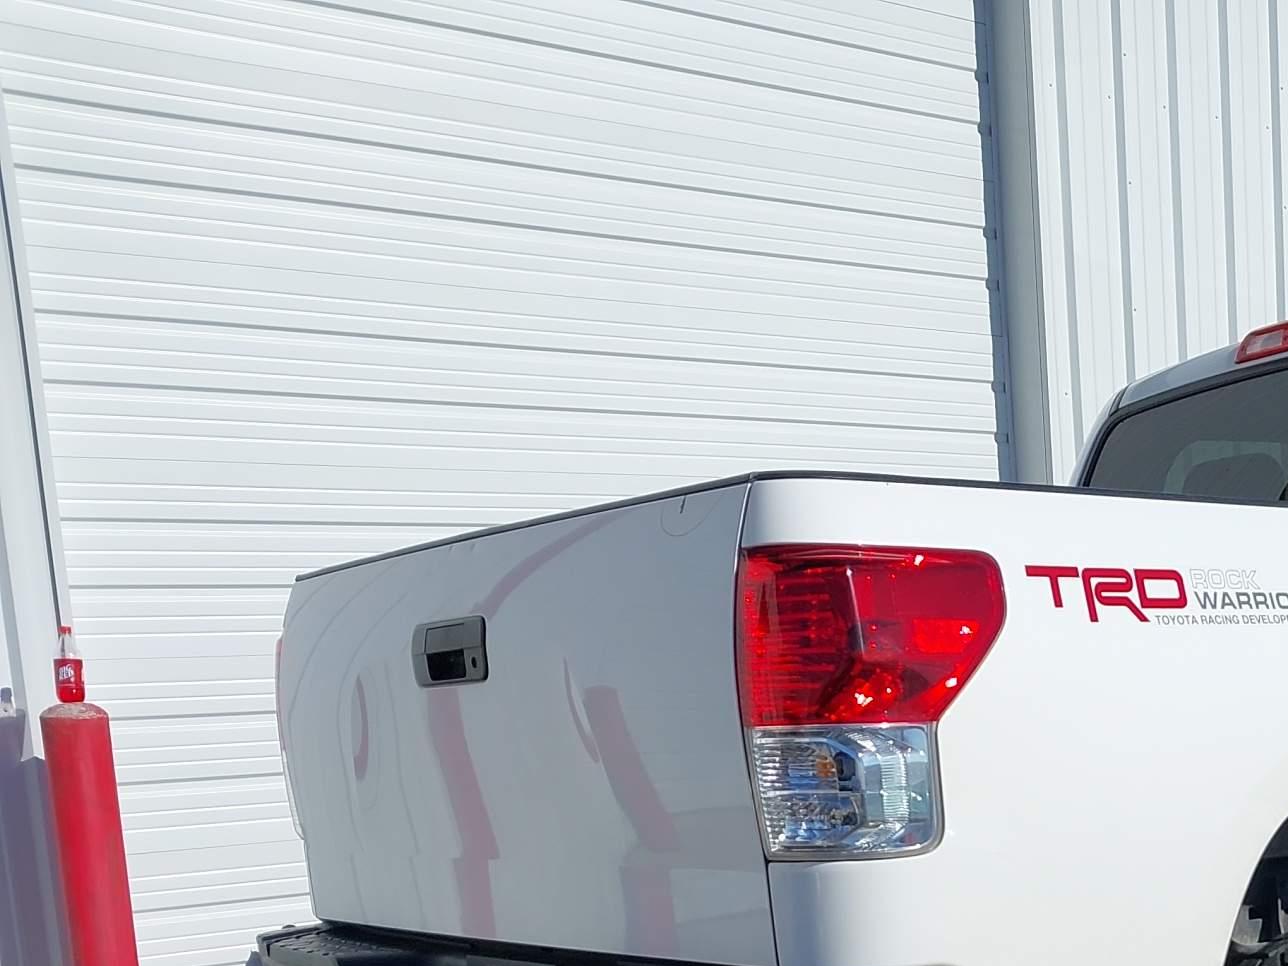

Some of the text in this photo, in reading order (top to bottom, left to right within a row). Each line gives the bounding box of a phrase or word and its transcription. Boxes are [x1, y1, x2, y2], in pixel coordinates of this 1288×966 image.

[1189, 568, 1261, 590] ROCK
[1025, 565, 1187, 622] TRD
[1155, 614, 1198, 625] TOYOTA
[1200, 614, 1240, 625] RACING
